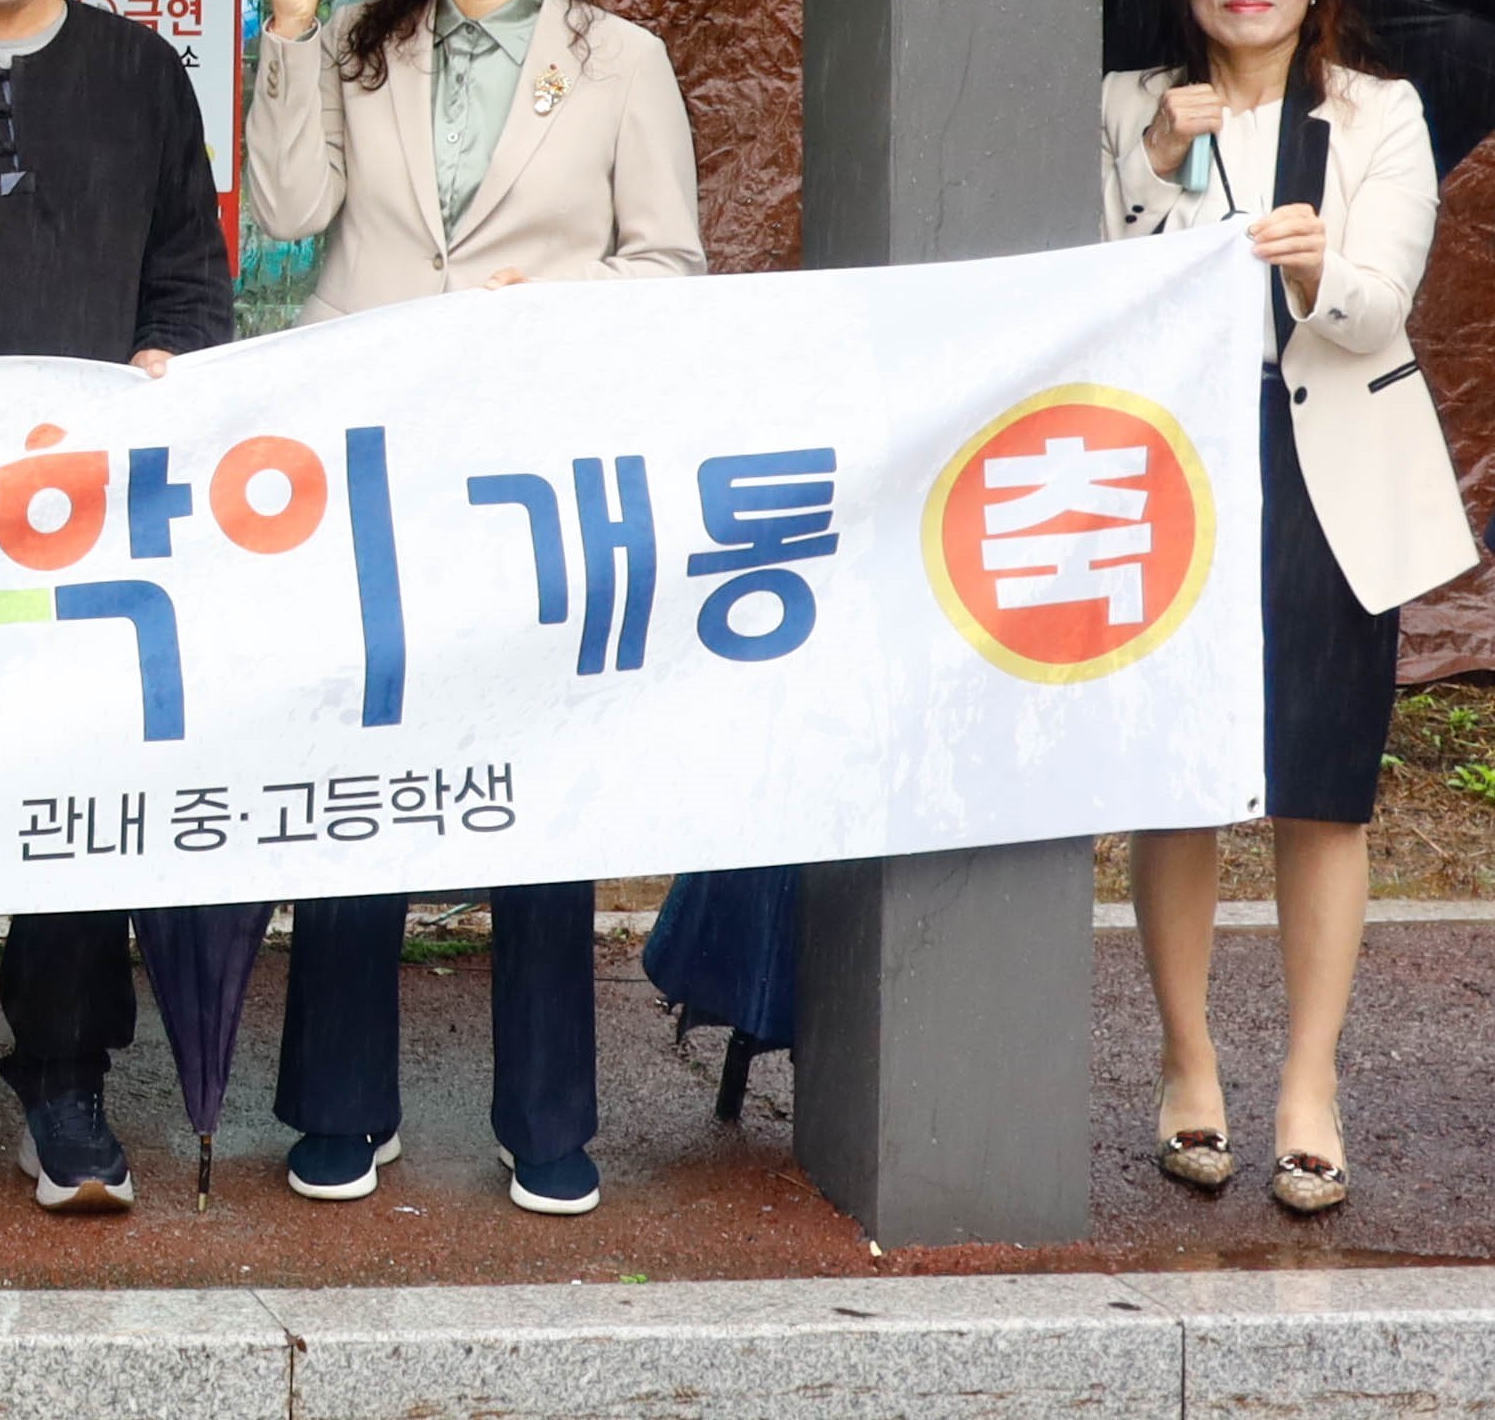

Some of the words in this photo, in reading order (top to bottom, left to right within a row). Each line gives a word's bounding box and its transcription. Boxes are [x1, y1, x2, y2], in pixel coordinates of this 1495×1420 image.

[465, 446, 841, 677] 개통
[980, 435, 1154, 626] 축
[17, 791, 146, 858] 관내
[169, 761, 516, 852] 중·고등학생
